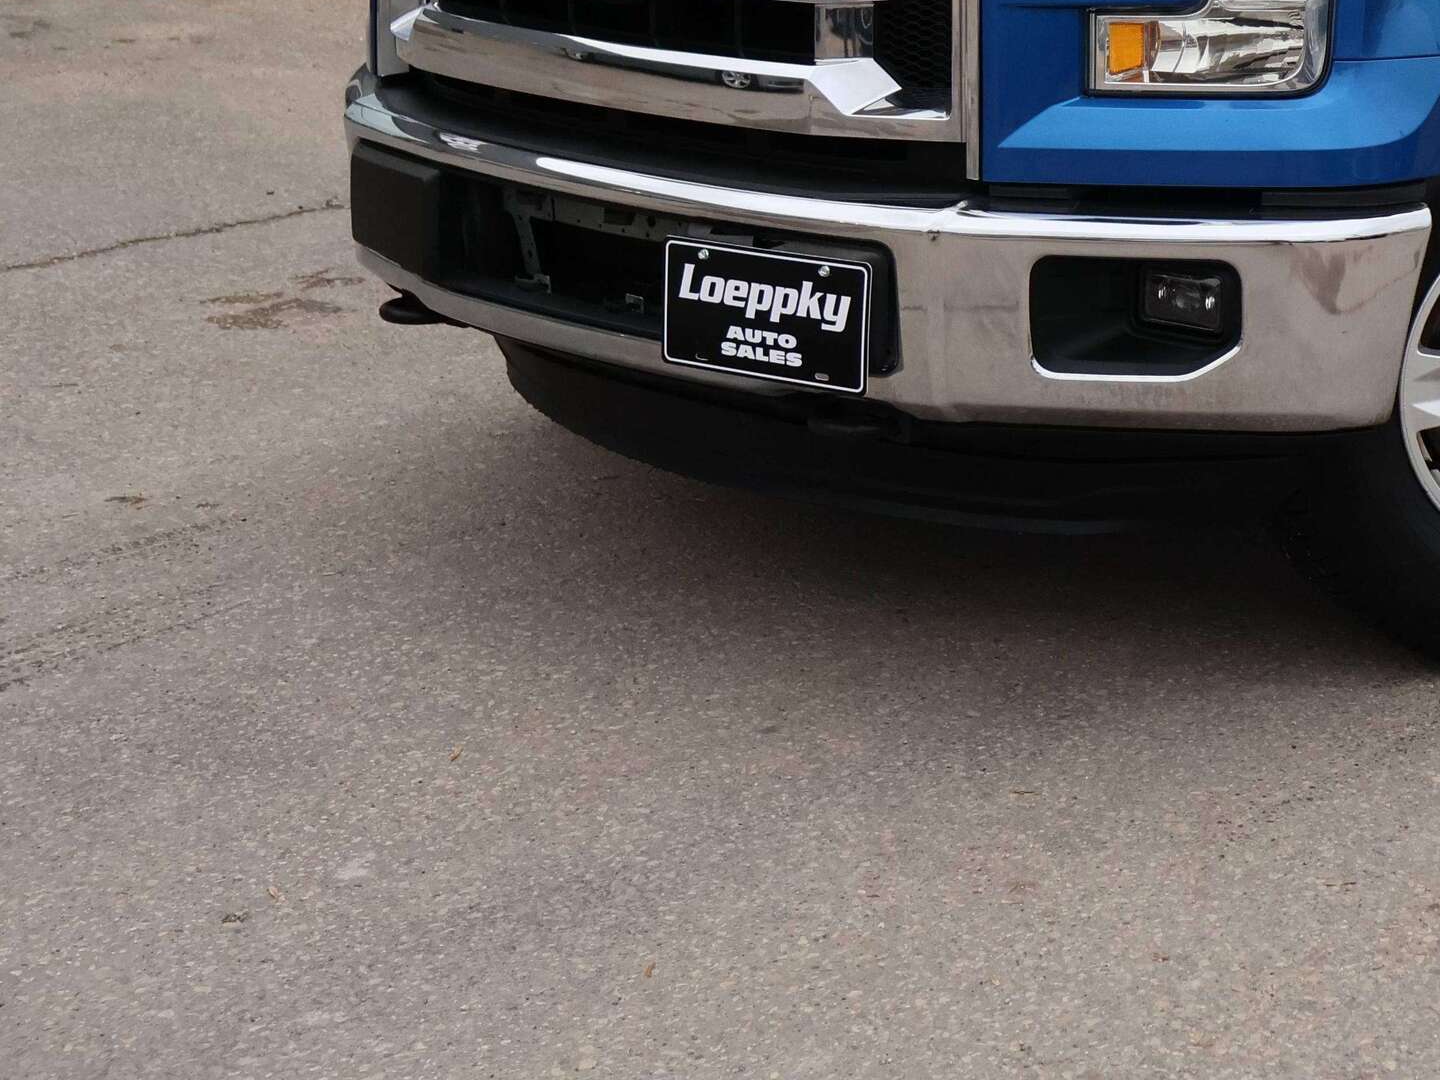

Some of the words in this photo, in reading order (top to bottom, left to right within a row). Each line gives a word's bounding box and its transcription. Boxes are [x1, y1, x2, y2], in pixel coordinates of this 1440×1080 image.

[678, 262, 852, 333] Loeppky
[726, 325, 798, 350] AUTO
[721, 341, 803, 368] SALES
